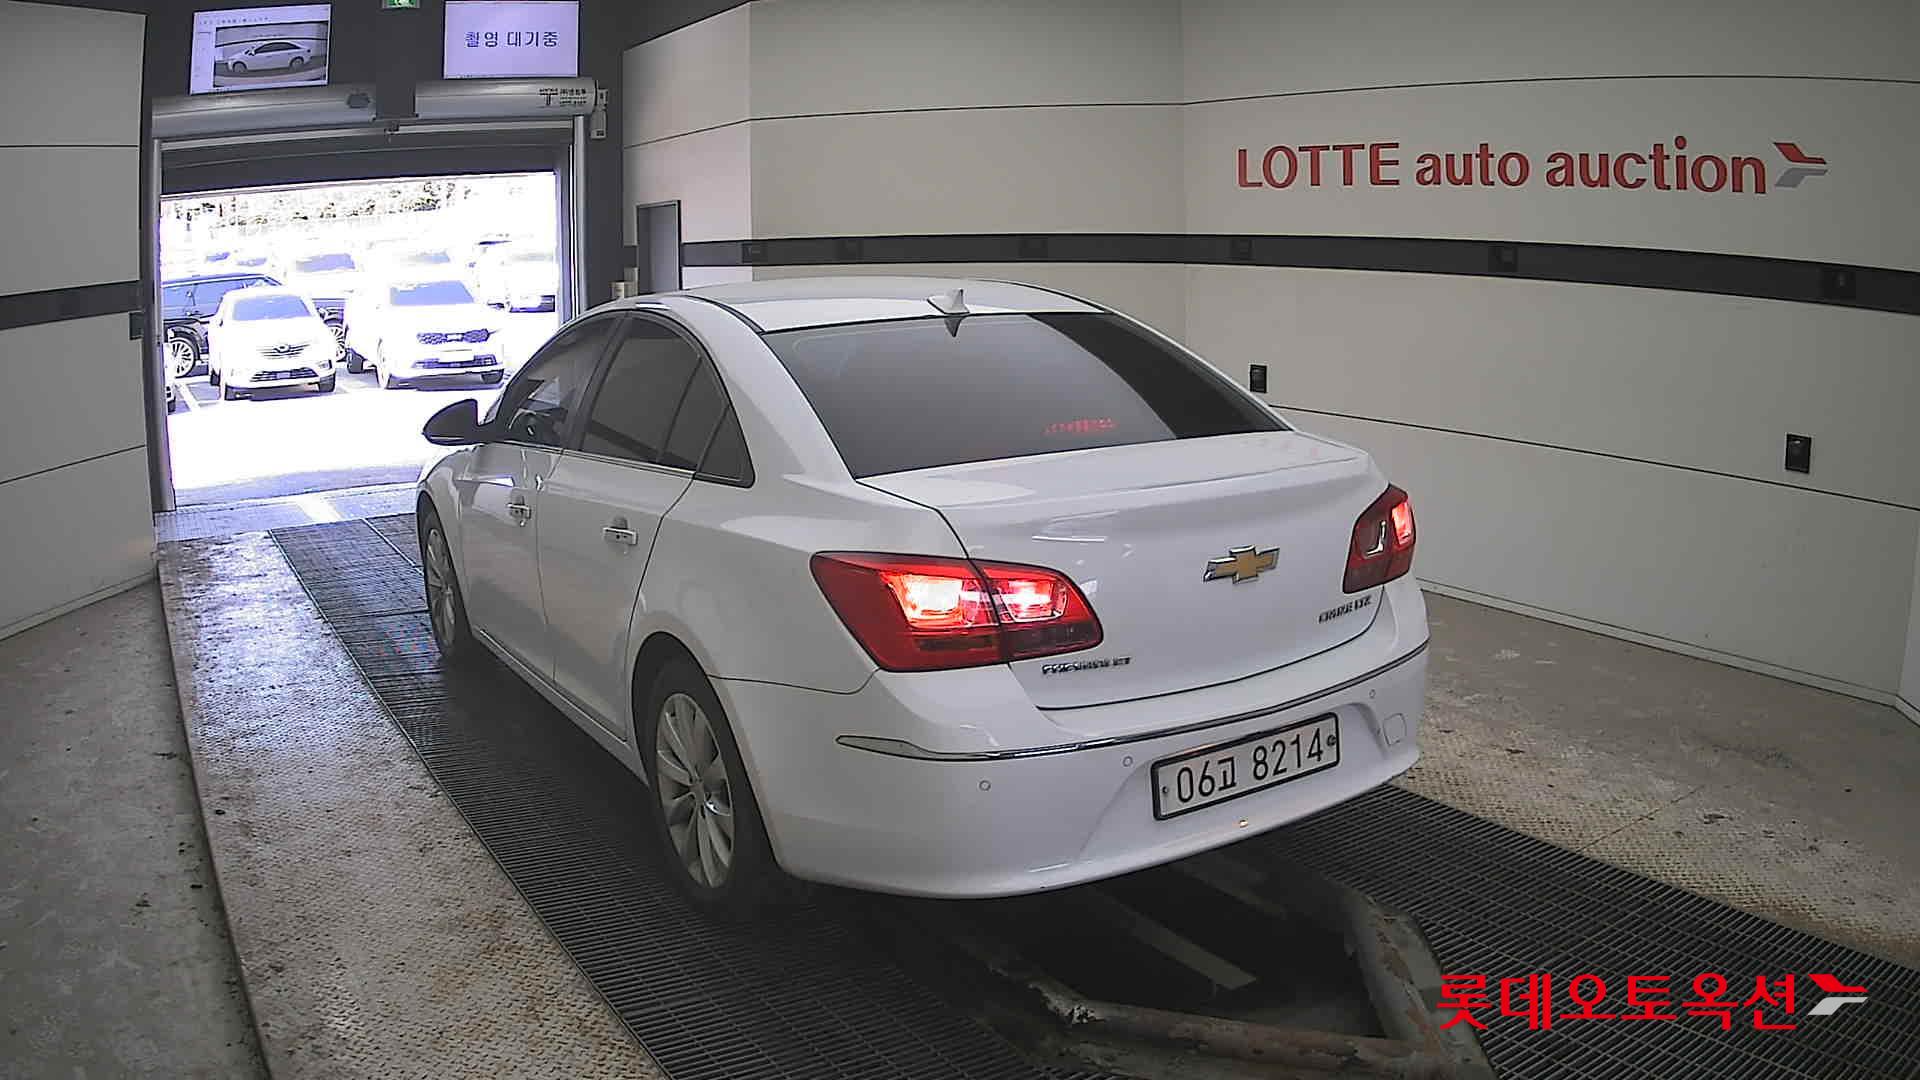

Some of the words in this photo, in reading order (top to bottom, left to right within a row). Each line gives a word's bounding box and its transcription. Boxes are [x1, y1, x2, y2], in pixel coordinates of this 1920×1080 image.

[507, 31, 559, 48] 대기중
[1237, 143, 1400, 188] LOTTE
[1415, 144, 1531, 187] auto
[1545, 136, 1767, 194] auction
[1176, 756, 1237, 803] 06고
[1252, 727, 1324, 781] 8214
